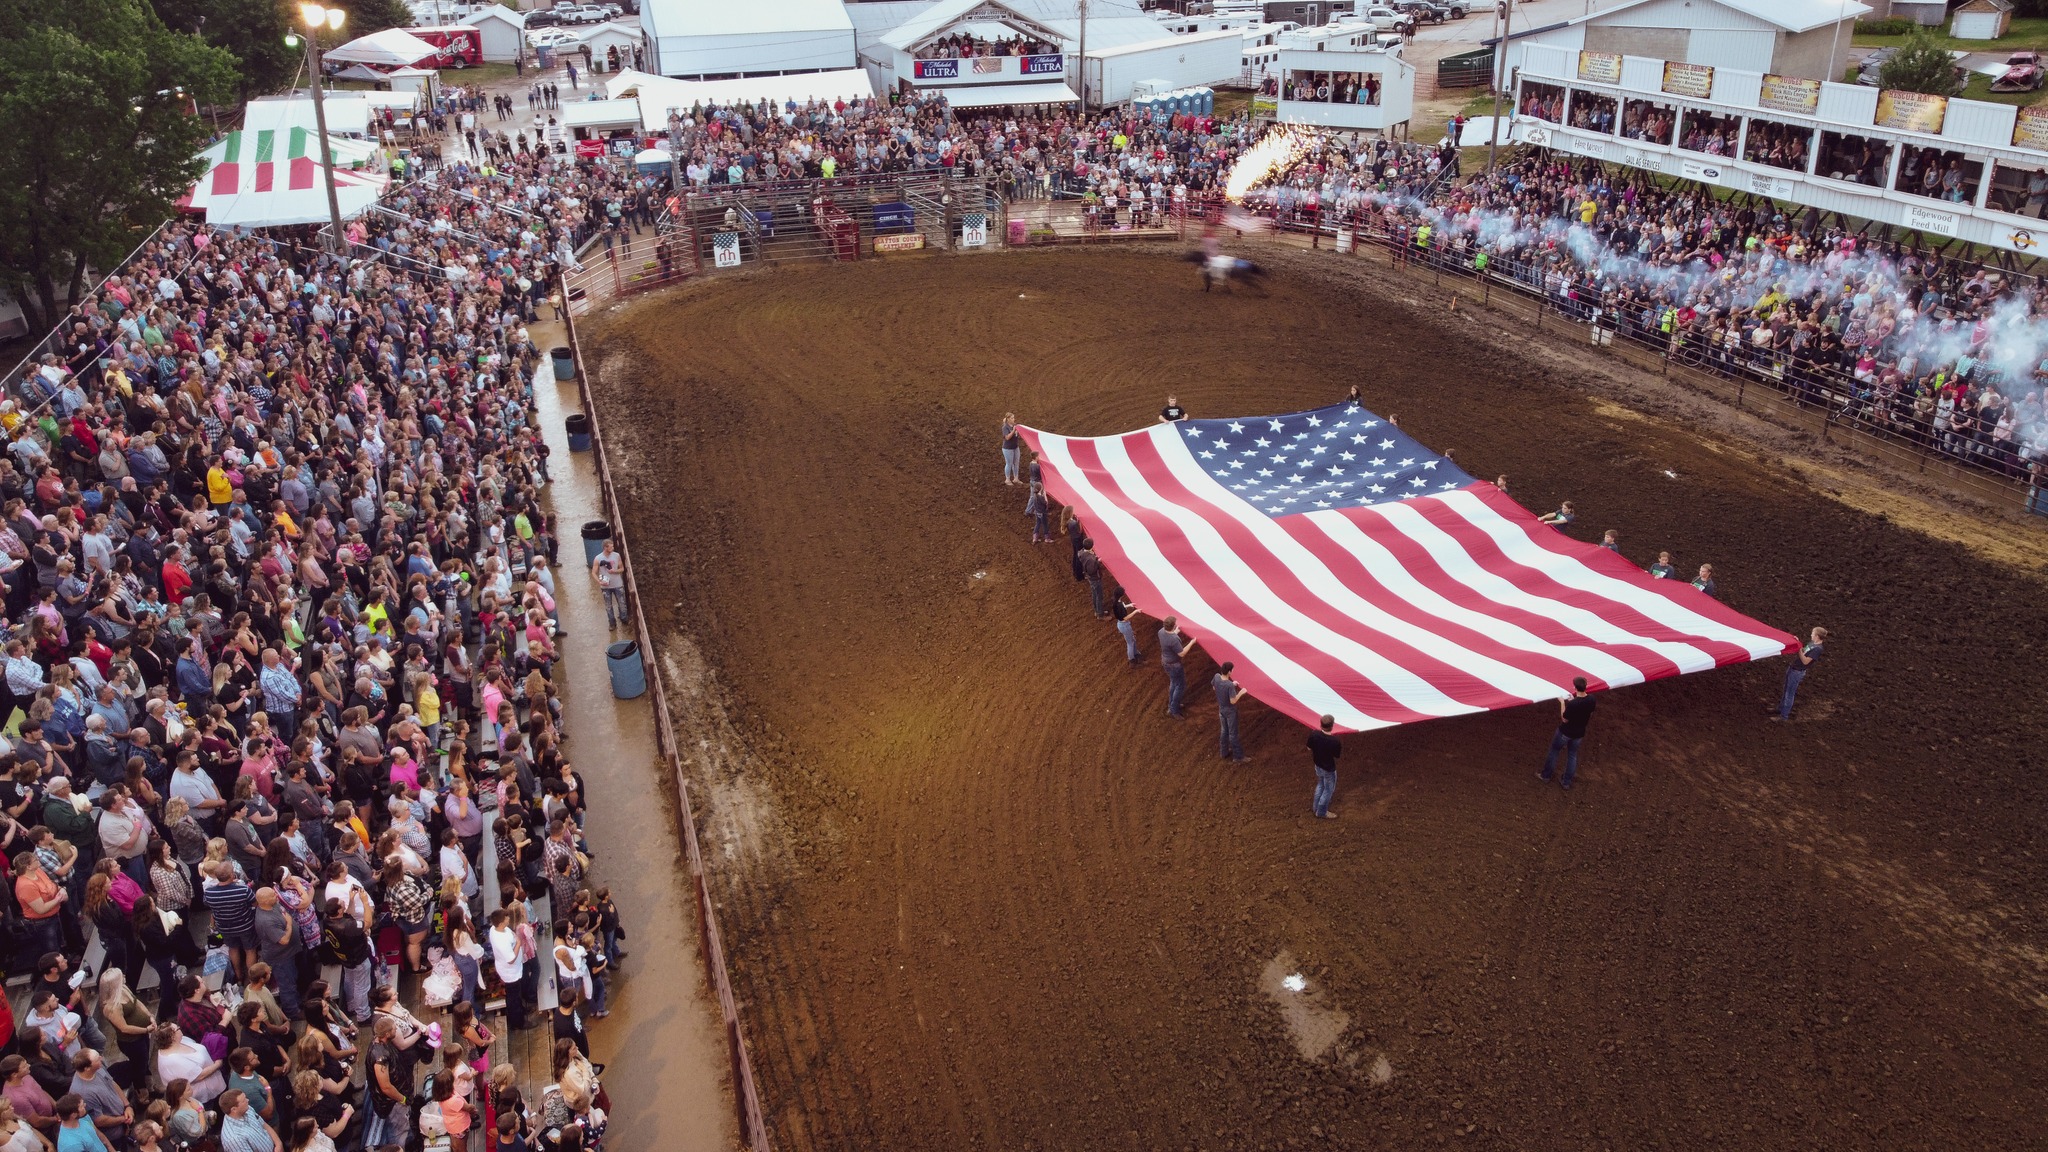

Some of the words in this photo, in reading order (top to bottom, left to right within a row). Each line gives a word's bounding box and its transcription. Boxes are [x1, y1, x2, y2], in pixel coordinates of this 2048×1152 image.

[436, 34, 470, 60] Coca-Cola
[924, 68, 957, 77] ULTRA
[1030, 63, 1062, 72] ULTRA
[1780, 76, 1803, 85] JUDGES
[1888, 90, 1916, 101] RESCUE
[1917, 93, 1936, 103] RACE
[2024, 107, 2048, 118] BARR
[1635, 158, 1642, 167] AG
[1642, 158, 1661, 170] SERVICES
[1752, 173, 1773, 182] COMMUNITY
[1912, 208, 1952, 222] Edgewood
[1911, 218, 1930, 229] Feed
[1933, 223, 1949, 233] Mill
